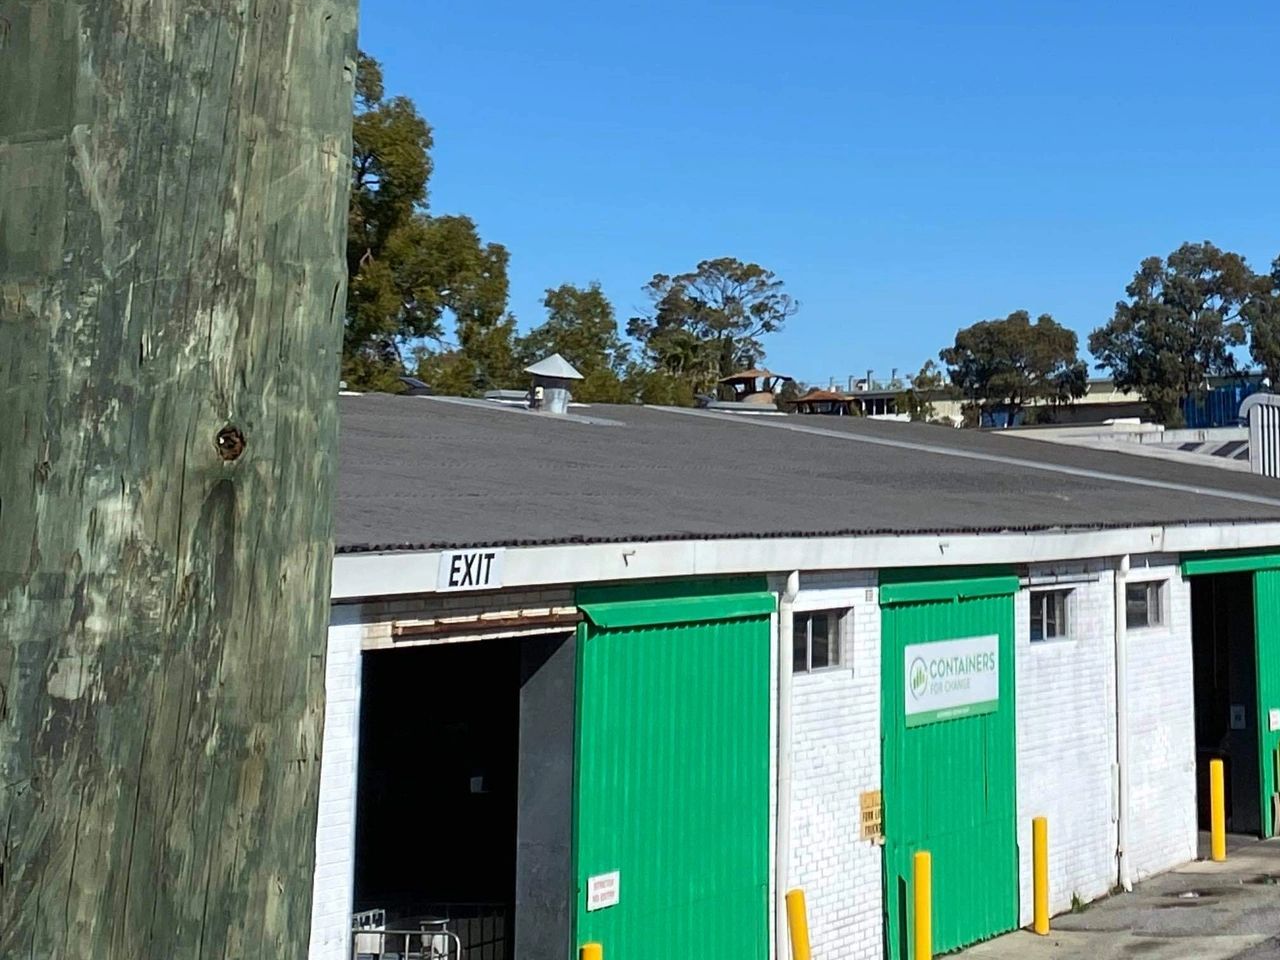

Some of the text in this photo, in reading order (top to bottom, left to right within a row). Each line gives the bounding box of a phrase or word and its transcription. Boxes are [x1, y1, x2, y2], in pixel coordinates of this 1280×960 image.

[448, 552, 496, 587] EXIT
[929, 652, 995, 679] CONTAINERS
[930, 678, 970, 695] FOR CHANGE
